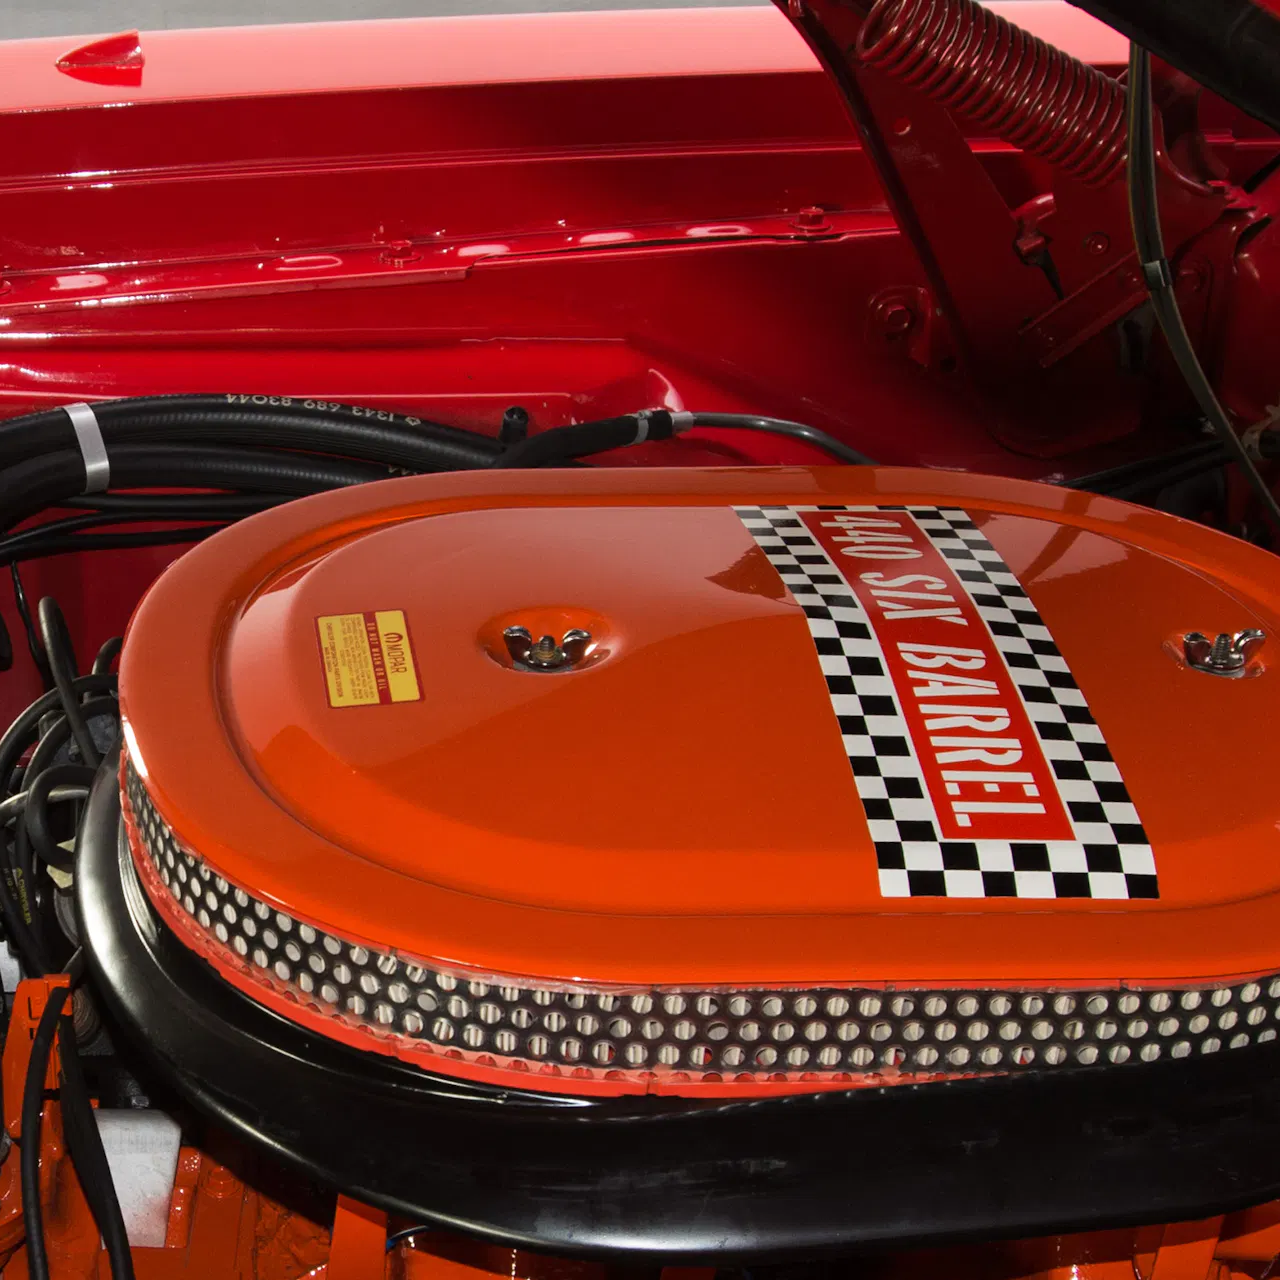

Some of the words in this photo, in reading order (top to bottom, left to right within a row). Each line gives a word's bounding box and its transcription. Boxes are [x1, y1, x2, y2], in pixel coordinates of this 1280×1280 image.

[303, 399, 341, 412] 689
[351, 405, 395, 423] 1343
[820, 514, 924, 561] 440
[859, 571, 969, 626] SIX
[386, 643, 407, 673] MOPAR
[896, 641, 1047, 828] BARREL
